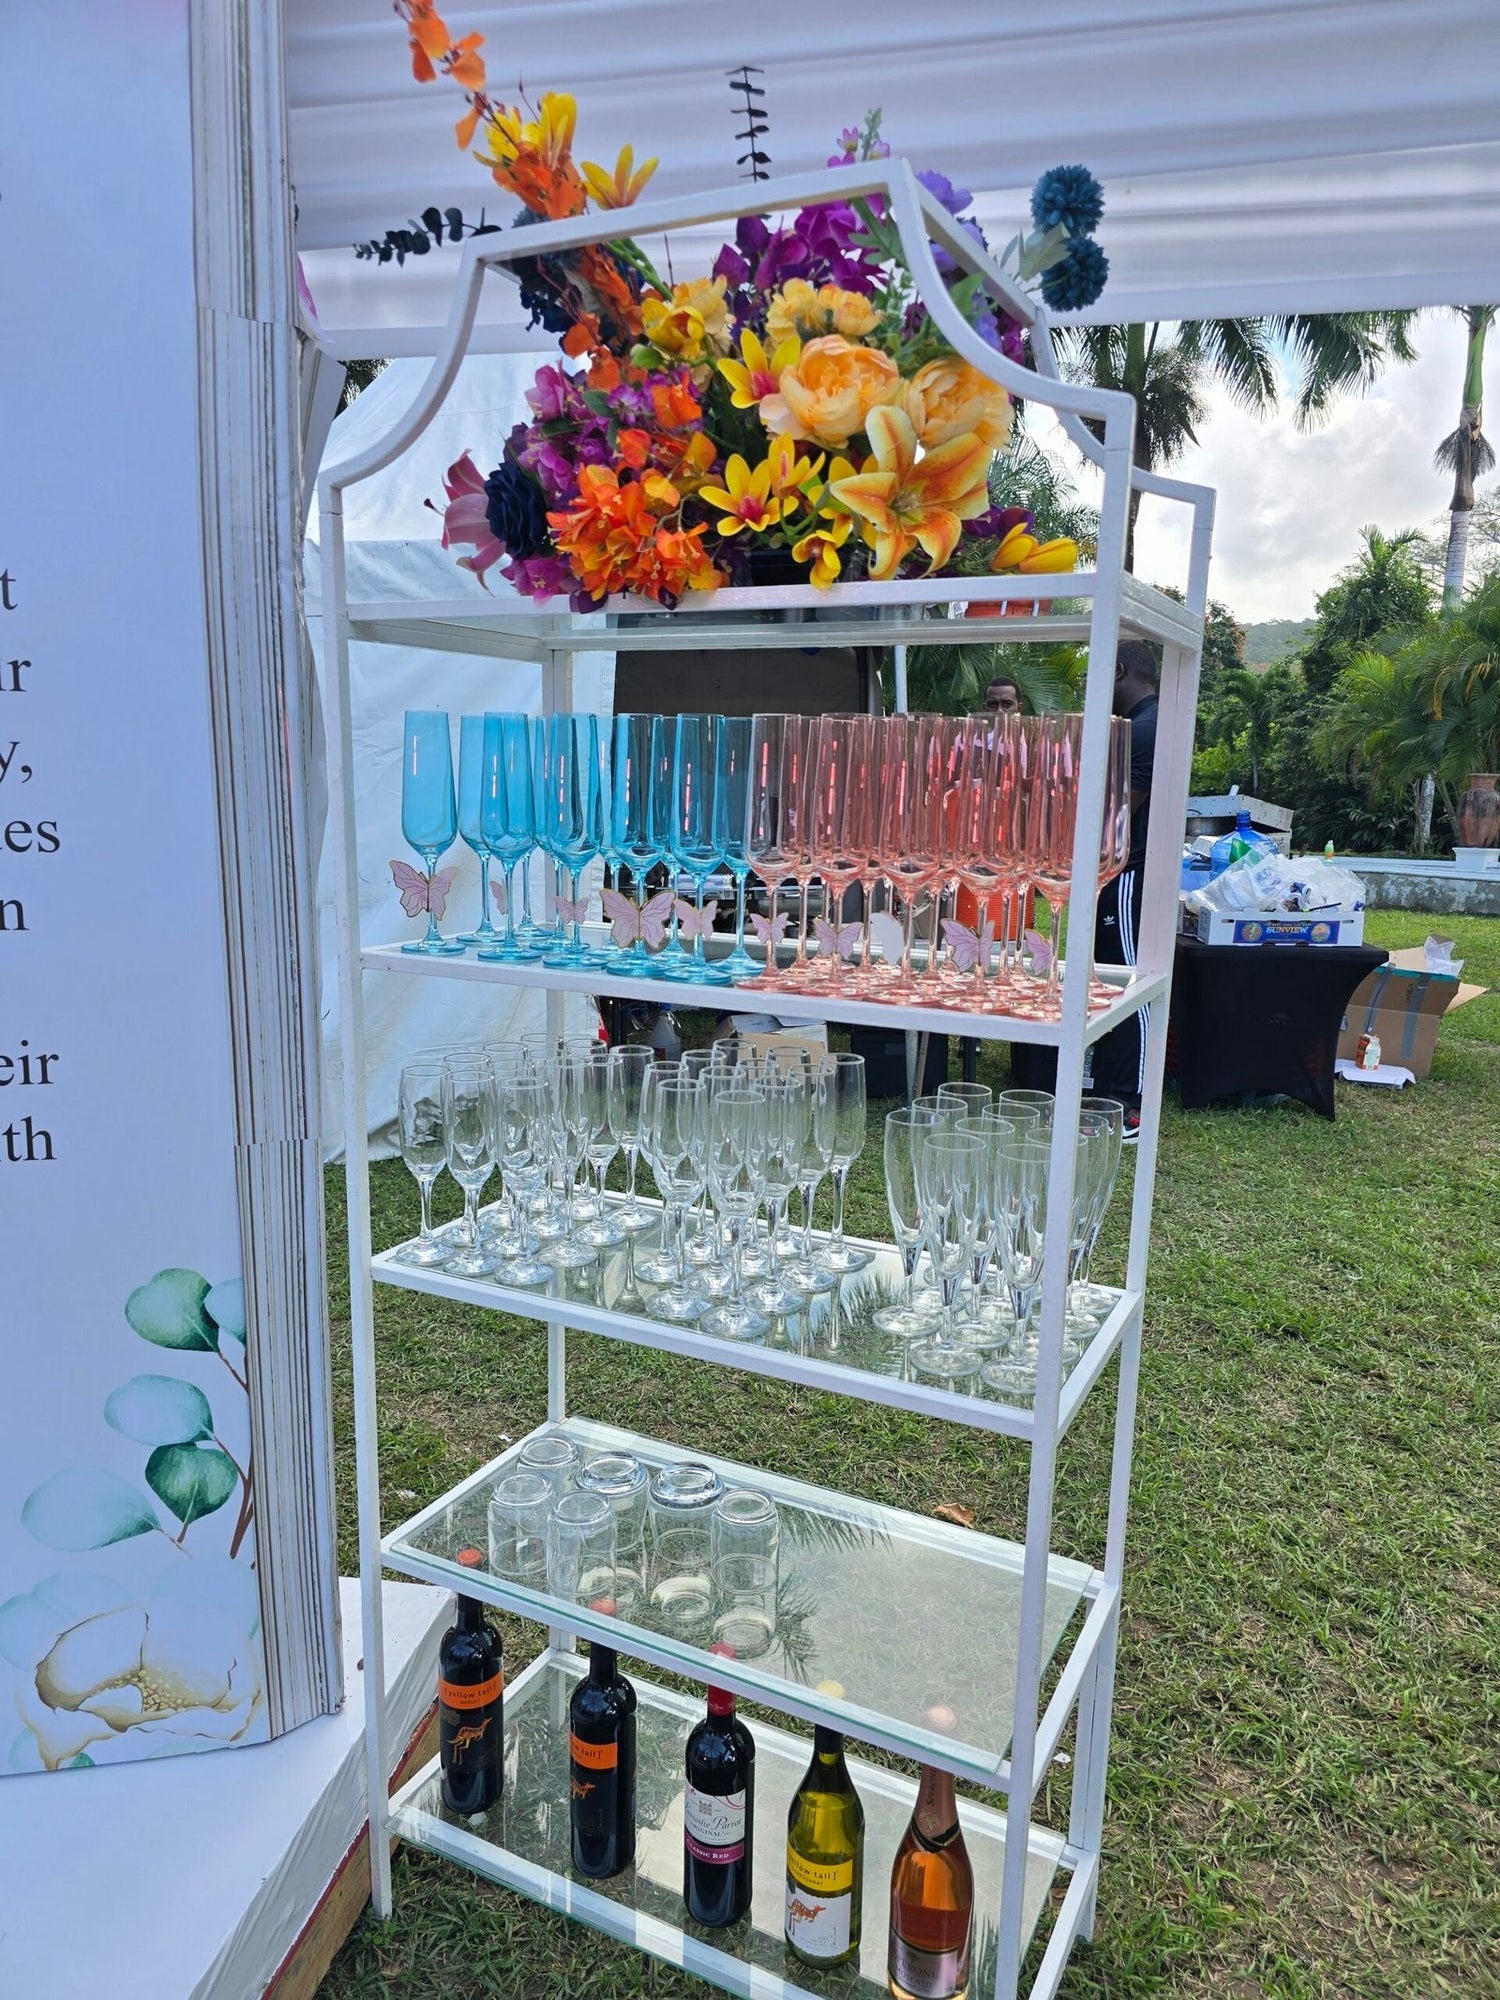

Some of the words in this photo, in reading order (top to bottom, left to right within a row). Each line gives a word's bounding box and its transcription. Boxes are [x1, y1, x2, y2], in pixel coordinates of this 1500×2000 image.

[0, 660, 32, 692] r
[0, 820, 61, 853] es
[1265, 926, 1309, 934] SUNVIEW
